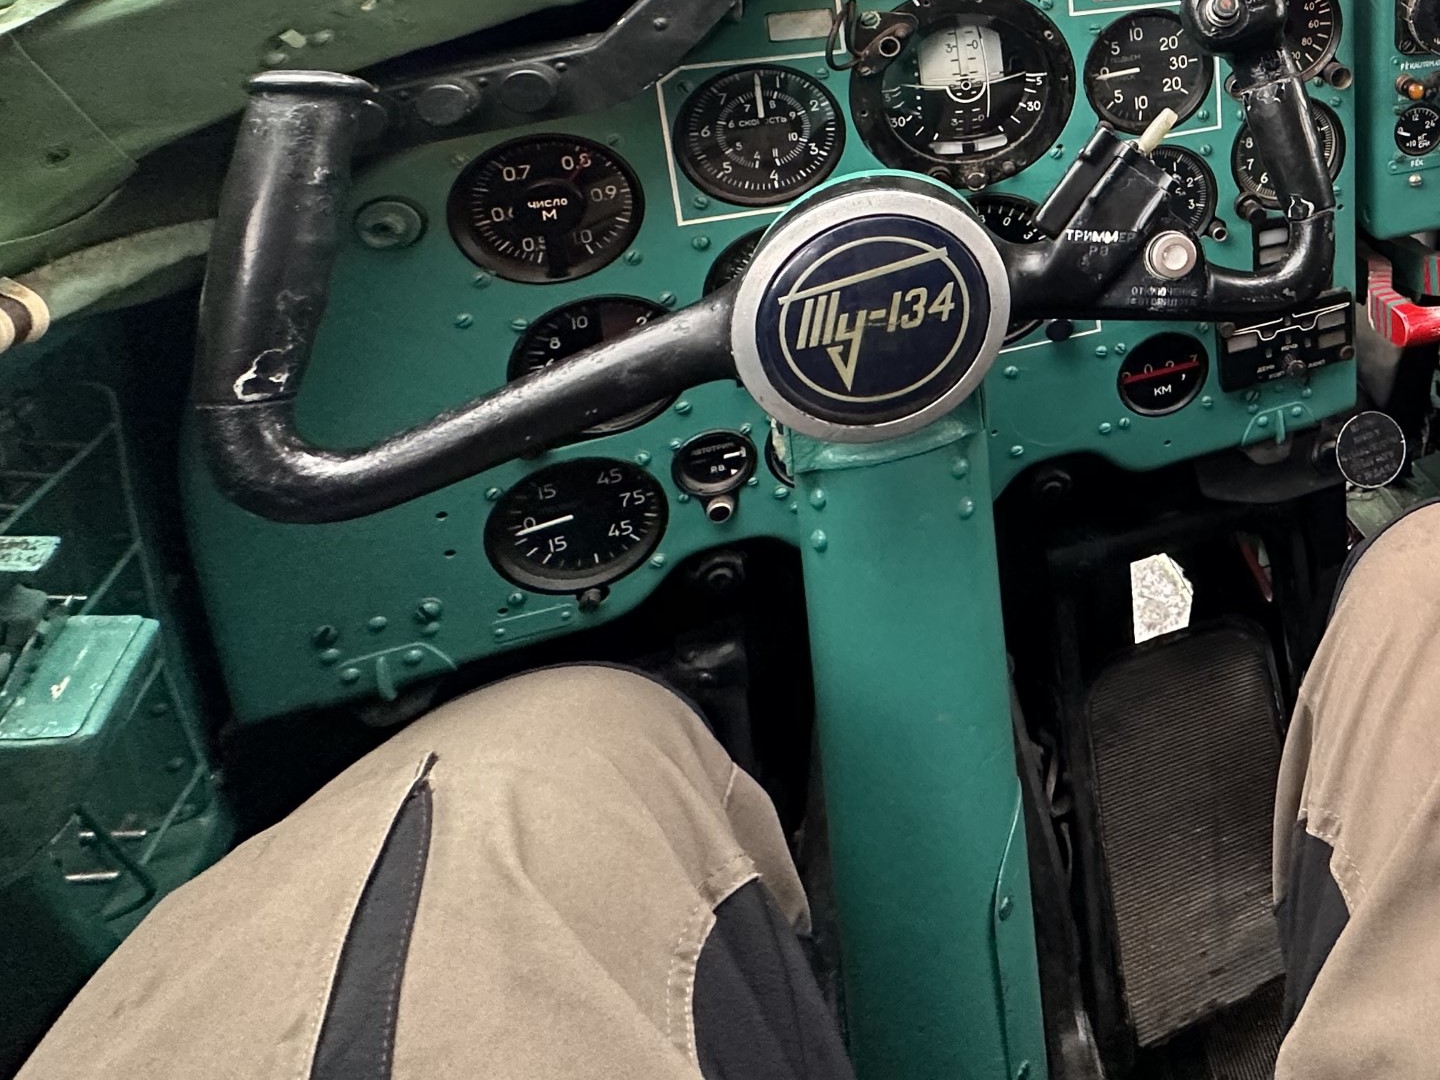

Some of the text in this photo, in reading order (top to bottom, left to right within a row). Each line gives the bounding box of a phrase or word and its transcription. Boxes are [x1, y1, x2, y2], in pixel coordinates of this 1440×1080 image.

[1304, 2, 1315, 12] 40
[1308, 19, 1319, 29] 60
[1129, 27, 1143, 42] 10
[1159, 35, 1179, 51] 20
[1301, 37, 1312, 46] 80
[1111, 41, 1120, 56] 5
[1169, 55, 1188, 70] 30
[1162, 76, 1182, 93] 20
[718, 92, 728, 106] 7
[1114, 89, 1124, 104] 5
[1134, 95, 1149, 110] 10
[743, 104, 751, 113] 7
[809, 99, 820, 112] 2
[1026, 100, 1041, 112] 30
[789, 111, 796, 120] 9
[728, 119, 735, 129] 6
[891, 116, 906, 128] 30
[700, 125, 711, 138] 6
[788, 131, 799, 142] 10
[735, 141, 743, 151] 5
[1246, 137, 1253, 148] 8
[808, 142, 819, 156] 3
[753, 151, 761, 160] 4
[722, 161, 733, 174] 5
[1247, 158, 1255, 170] 7
[502, 164, 531, 182] 0.7
[769, 169, 779, 181] 4
[1260, 172, 1268, 184] 6
[1186, 177, 1194, 188] 2
[590, 185, 617, 202] 0.9
[527, 197, 568, 209] ЧИСЛО
[1188, 199, 1196, 210] 3
[541, 209, 558, 221] М
[1003, 216, 1012, 226] 0
[1023, 231, 1034, 240] 3
[1066, 228, 1136, 244] ТРИММЕР
[571, 315, 588, 330] 10
[549, 337, 561, 349] 8
[1154, 384, 1172, 397] КМ
[597, 468, 623, 485] 45
[538, 485, 557, 500] 15
[619, 489, 645, 508] 75
[608, 520, 633, 537] 45
[548, 535, 568, 553] 15
